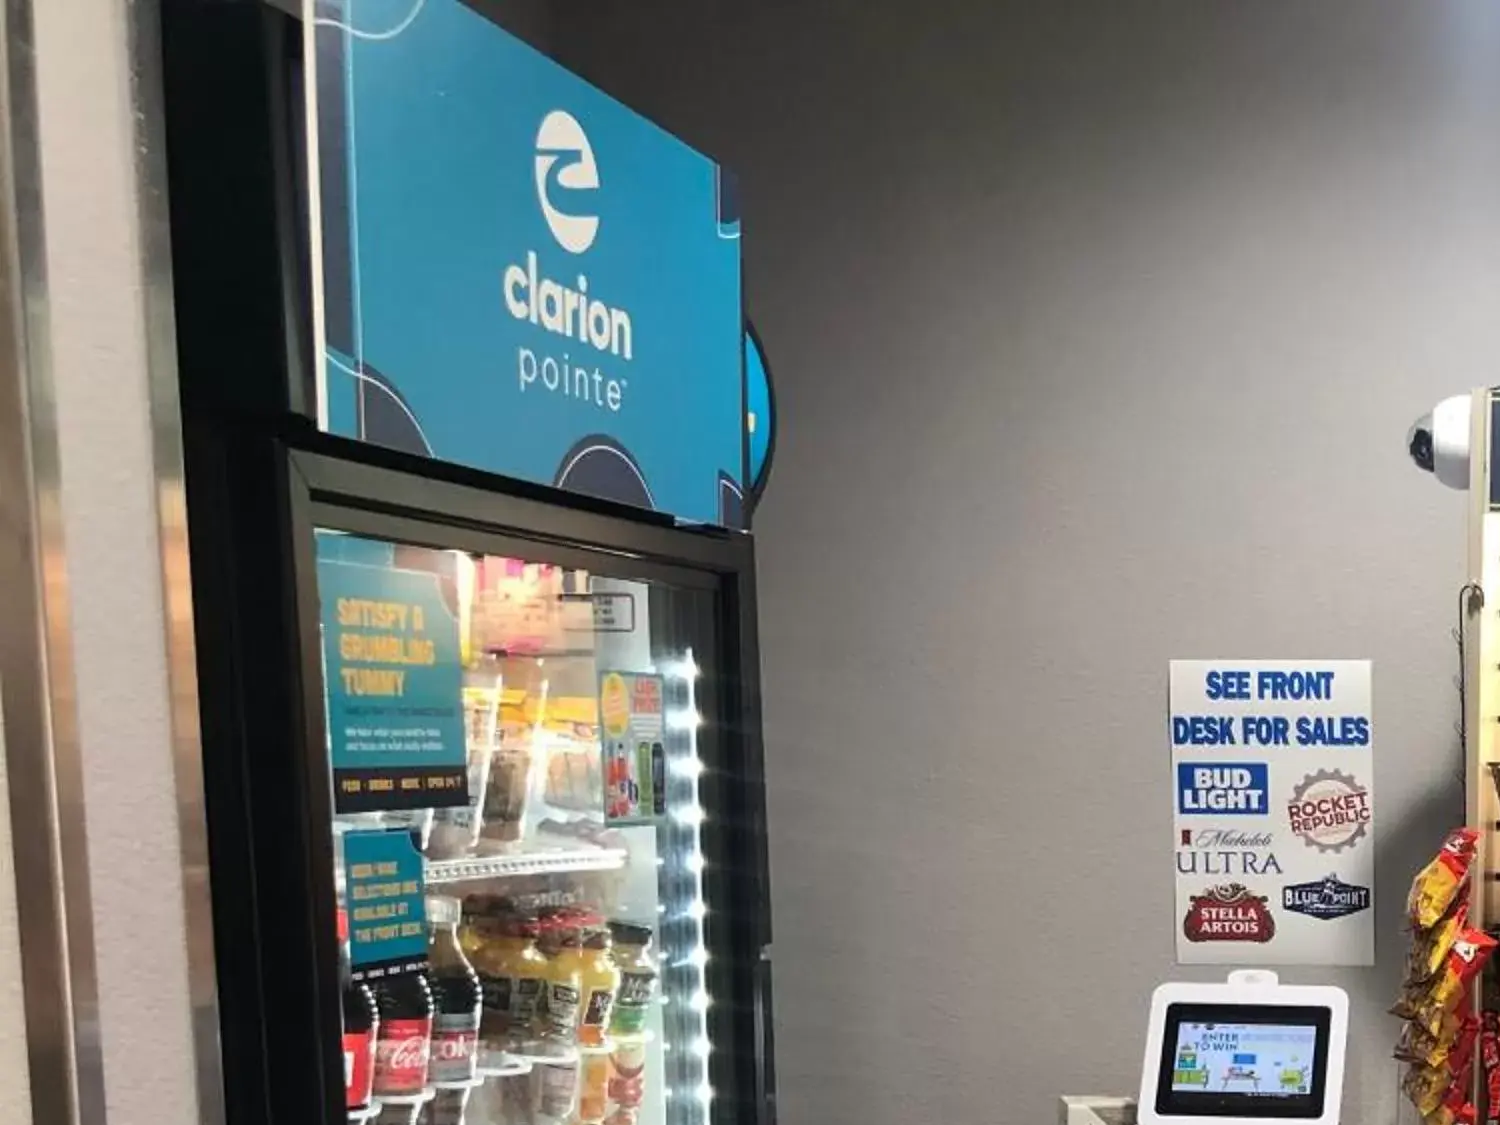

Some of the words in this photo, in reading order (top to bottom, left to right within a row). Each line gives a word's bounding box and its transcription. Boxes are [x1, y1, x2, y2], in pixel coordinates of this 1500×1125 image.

[504, 251, 633, 361] clarion
[519, 347, 622, 411] pointe
[340, 633, 434, 665] GRUMBLING
[341, 667, 404, 696] TUMMY
[1206, 672, 1251, 699] SEE
[1257, 672, 1334, 700] FRONT
[1173, 717, 1236, 745] DESK
[1242, 717, 1289, 745] FOR
[1295, 717, 1369, 746] SALES
[1194, 768, 1252, 789] BUD
[1184, 789, 1263, 810] LIGHT
[1288, 792, 1368, 820] ROCKET
[1291, 808, 1371, 833] REPUBLIC
[1177, 851, 1283, 875] ULTRA
[1285, 889, 1320, 905] BLUE
[1333, 890, 1367, 907] POINT
[1200, 907, 1258, 921] STELLA
[1200, 921, 1259, 934] ARTOIS
[1194, 1042, 1210, 1051] TO
[1212, 1042, 1238, 1051] WIN
[1202, 1033, 1238, 1042] ENTER
